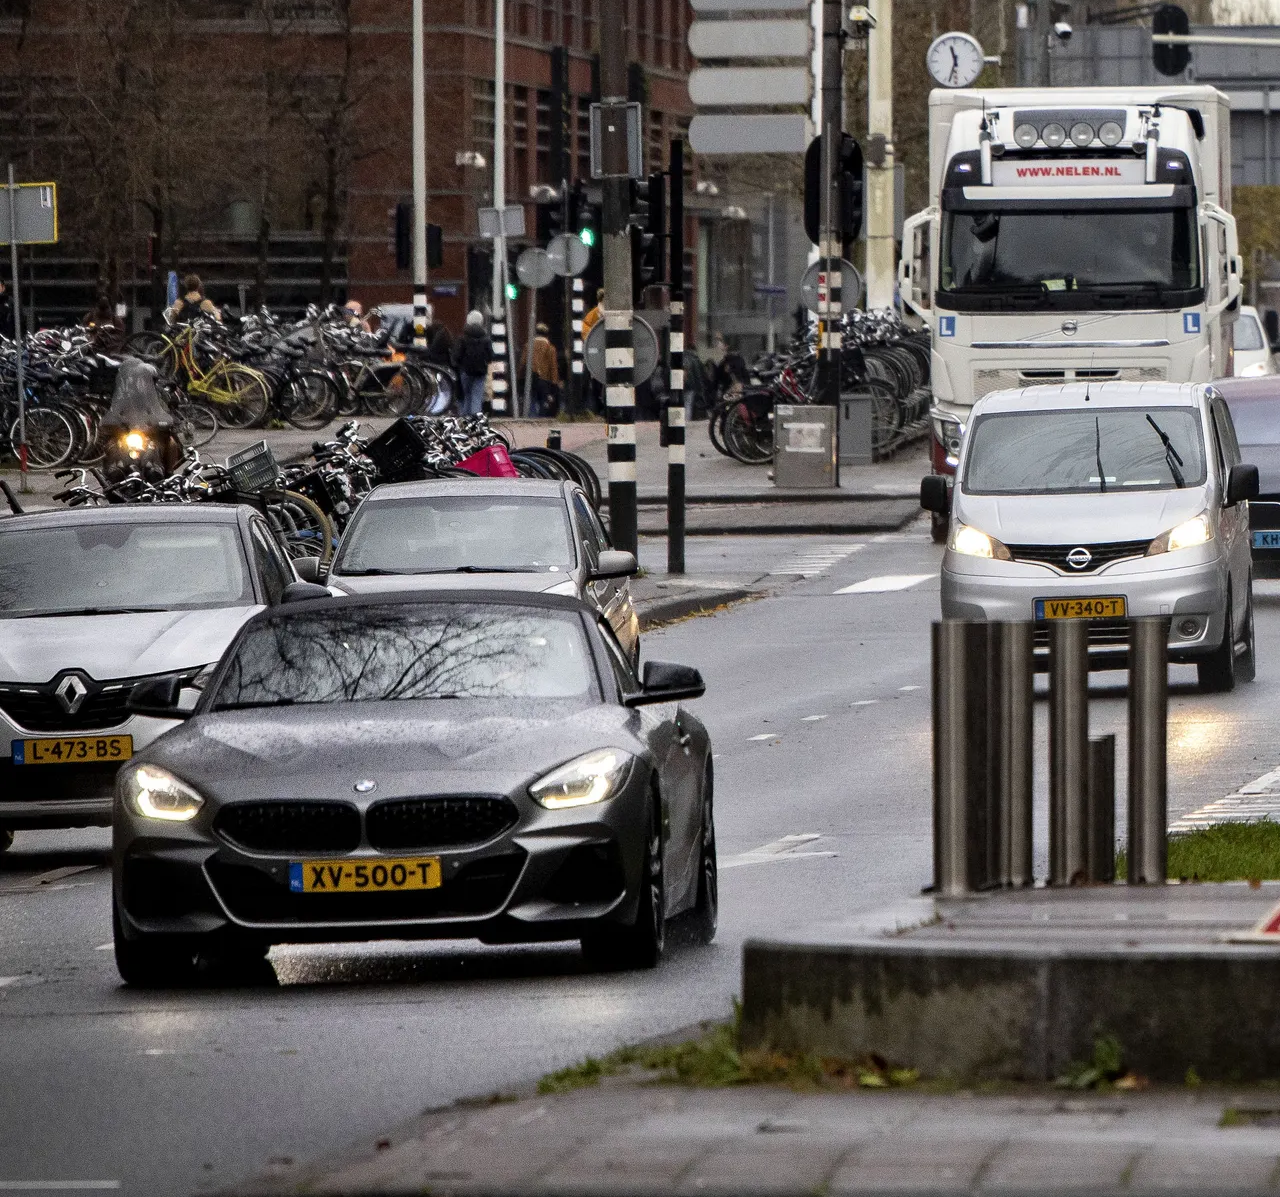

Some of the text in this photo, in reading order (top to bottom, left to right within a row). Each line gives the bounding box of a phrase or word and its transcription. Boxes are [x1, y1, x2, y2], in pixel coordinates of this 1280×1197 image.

[1016, 166, 1122, 178] WWW.NELEN.NL
[941, 318, 952, 334] L
[1186, 315, 1199, 331] L
[1050, 600, 1117, 616] VV-340-T
[32, 739, 121, 760] L-473-BS
[311, 863, 431, 888] XV-500-T
